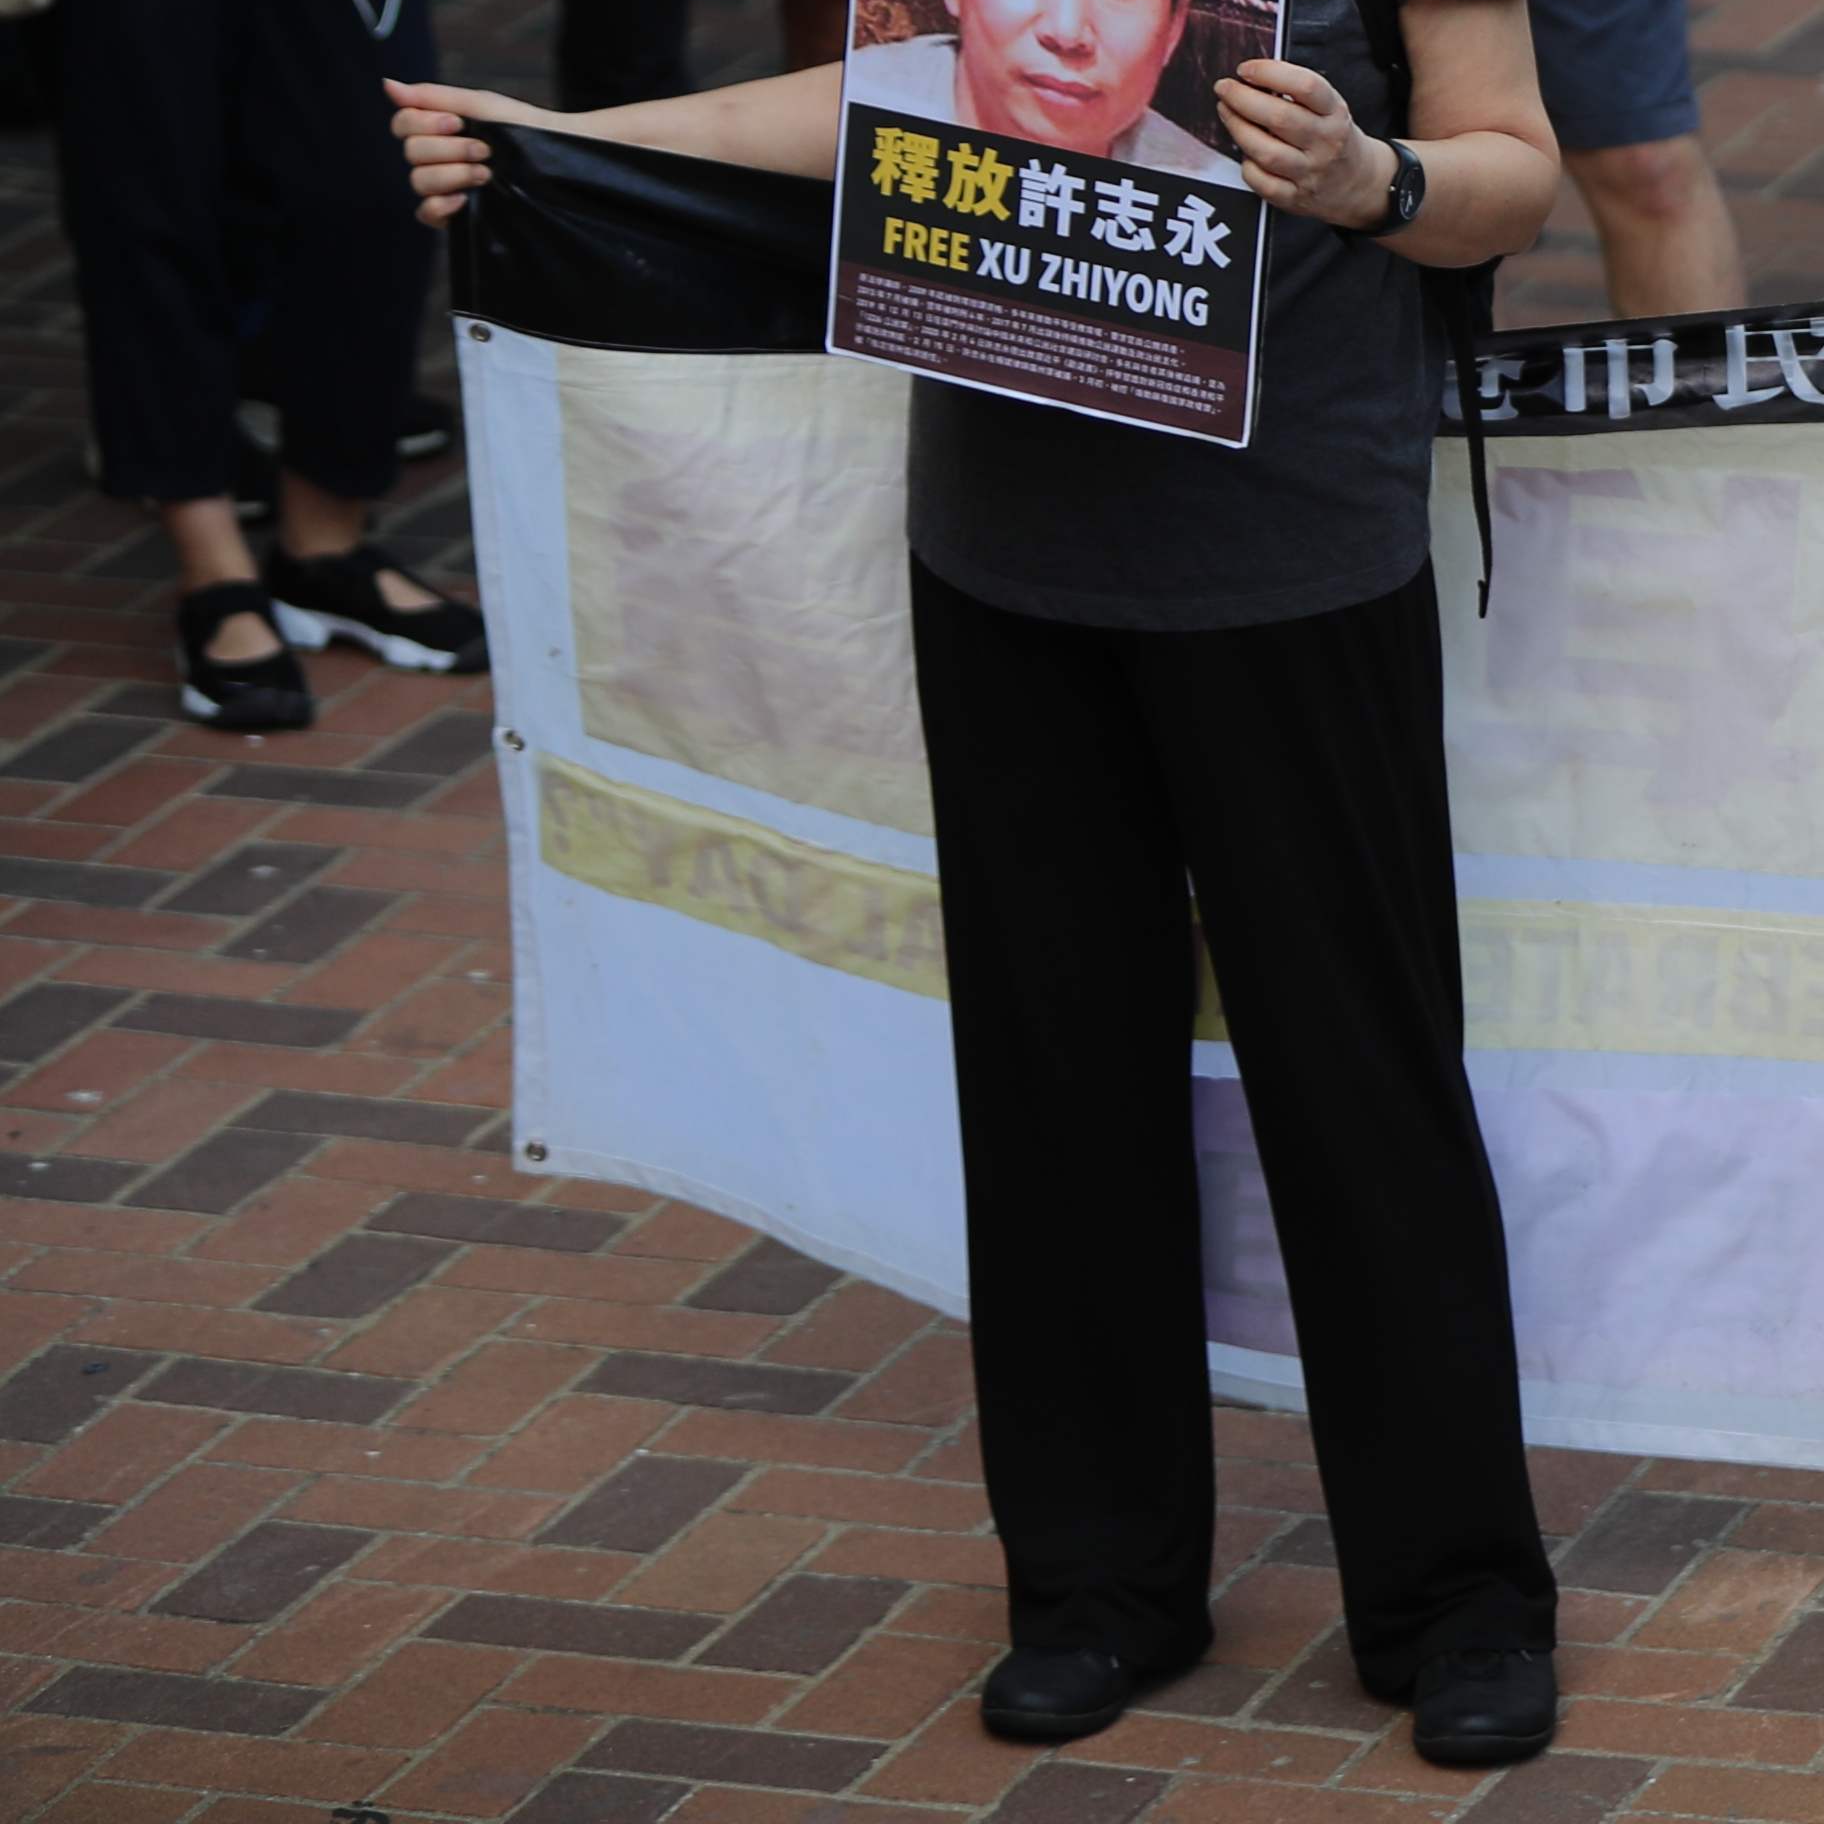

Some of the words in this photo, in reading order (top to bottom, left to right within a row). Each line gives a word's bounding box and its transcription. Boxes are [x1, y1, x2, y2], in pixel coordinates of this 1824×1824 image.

[871, 126, 1232, 269] 釋放許志永
[883, 217, 969, 272] FREE
[977, 238, 1031, 285] XU
[1038, 253, 1210, 326] ZHIYONG
